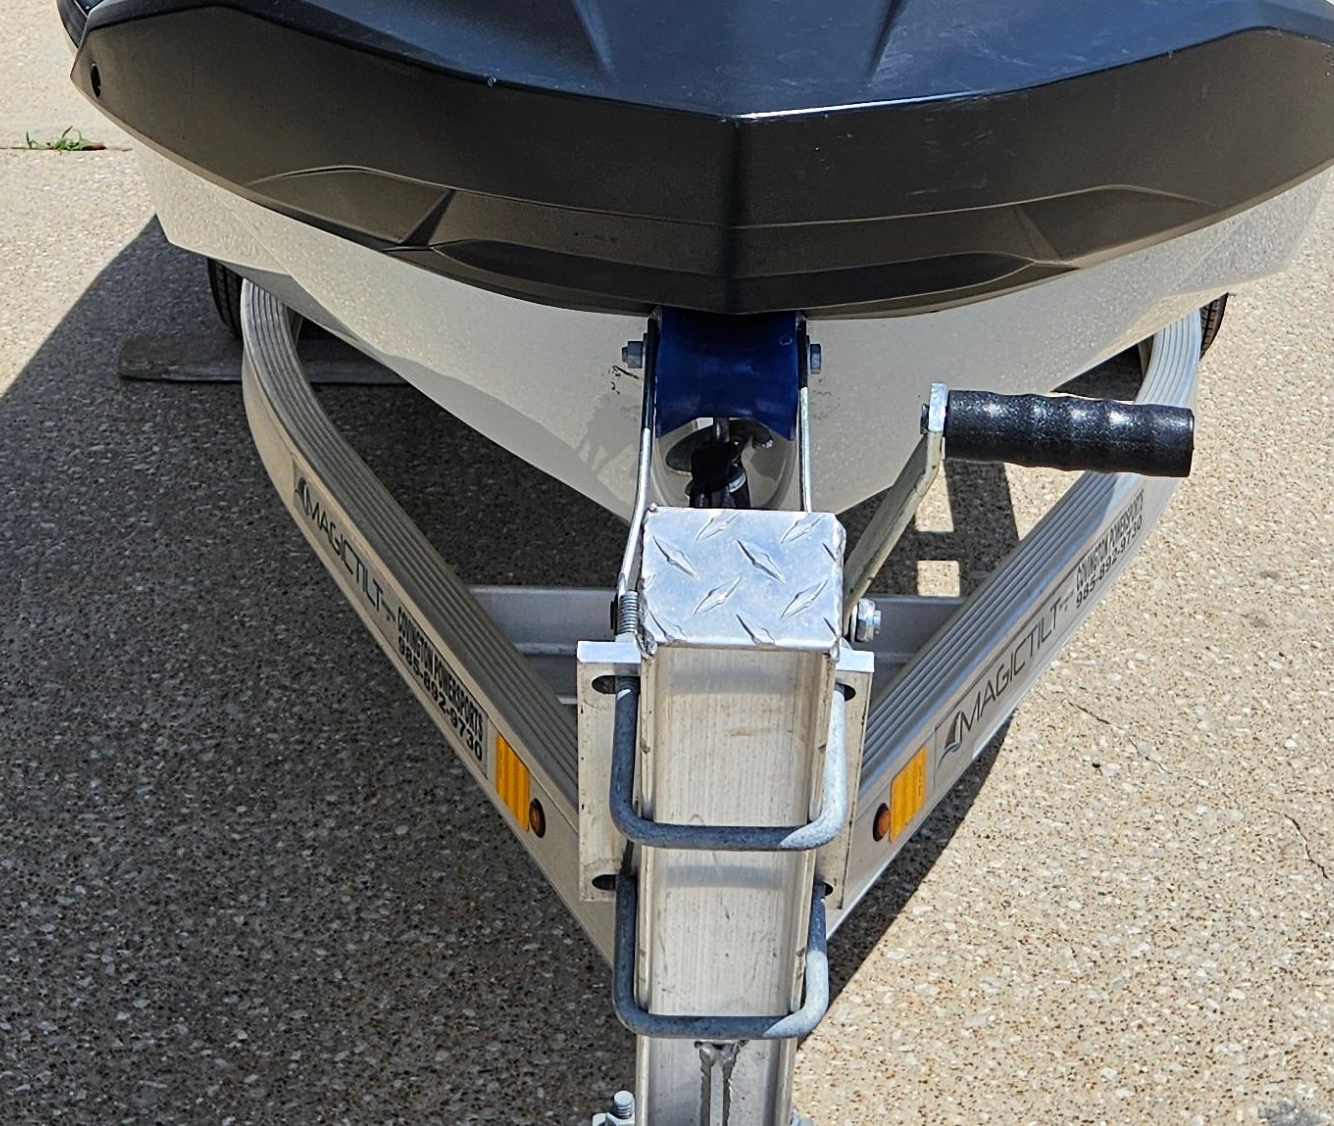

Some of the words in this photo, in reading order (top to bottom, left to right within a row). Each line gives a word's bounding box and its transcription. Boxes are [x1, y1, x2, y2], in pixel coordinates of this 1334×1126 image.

[1076, 514, 1143, 609] 985-892-9730
[398, 635, 483, 762] 985-892-9730
[960, 596, 1062, 742] MAGICTILT
